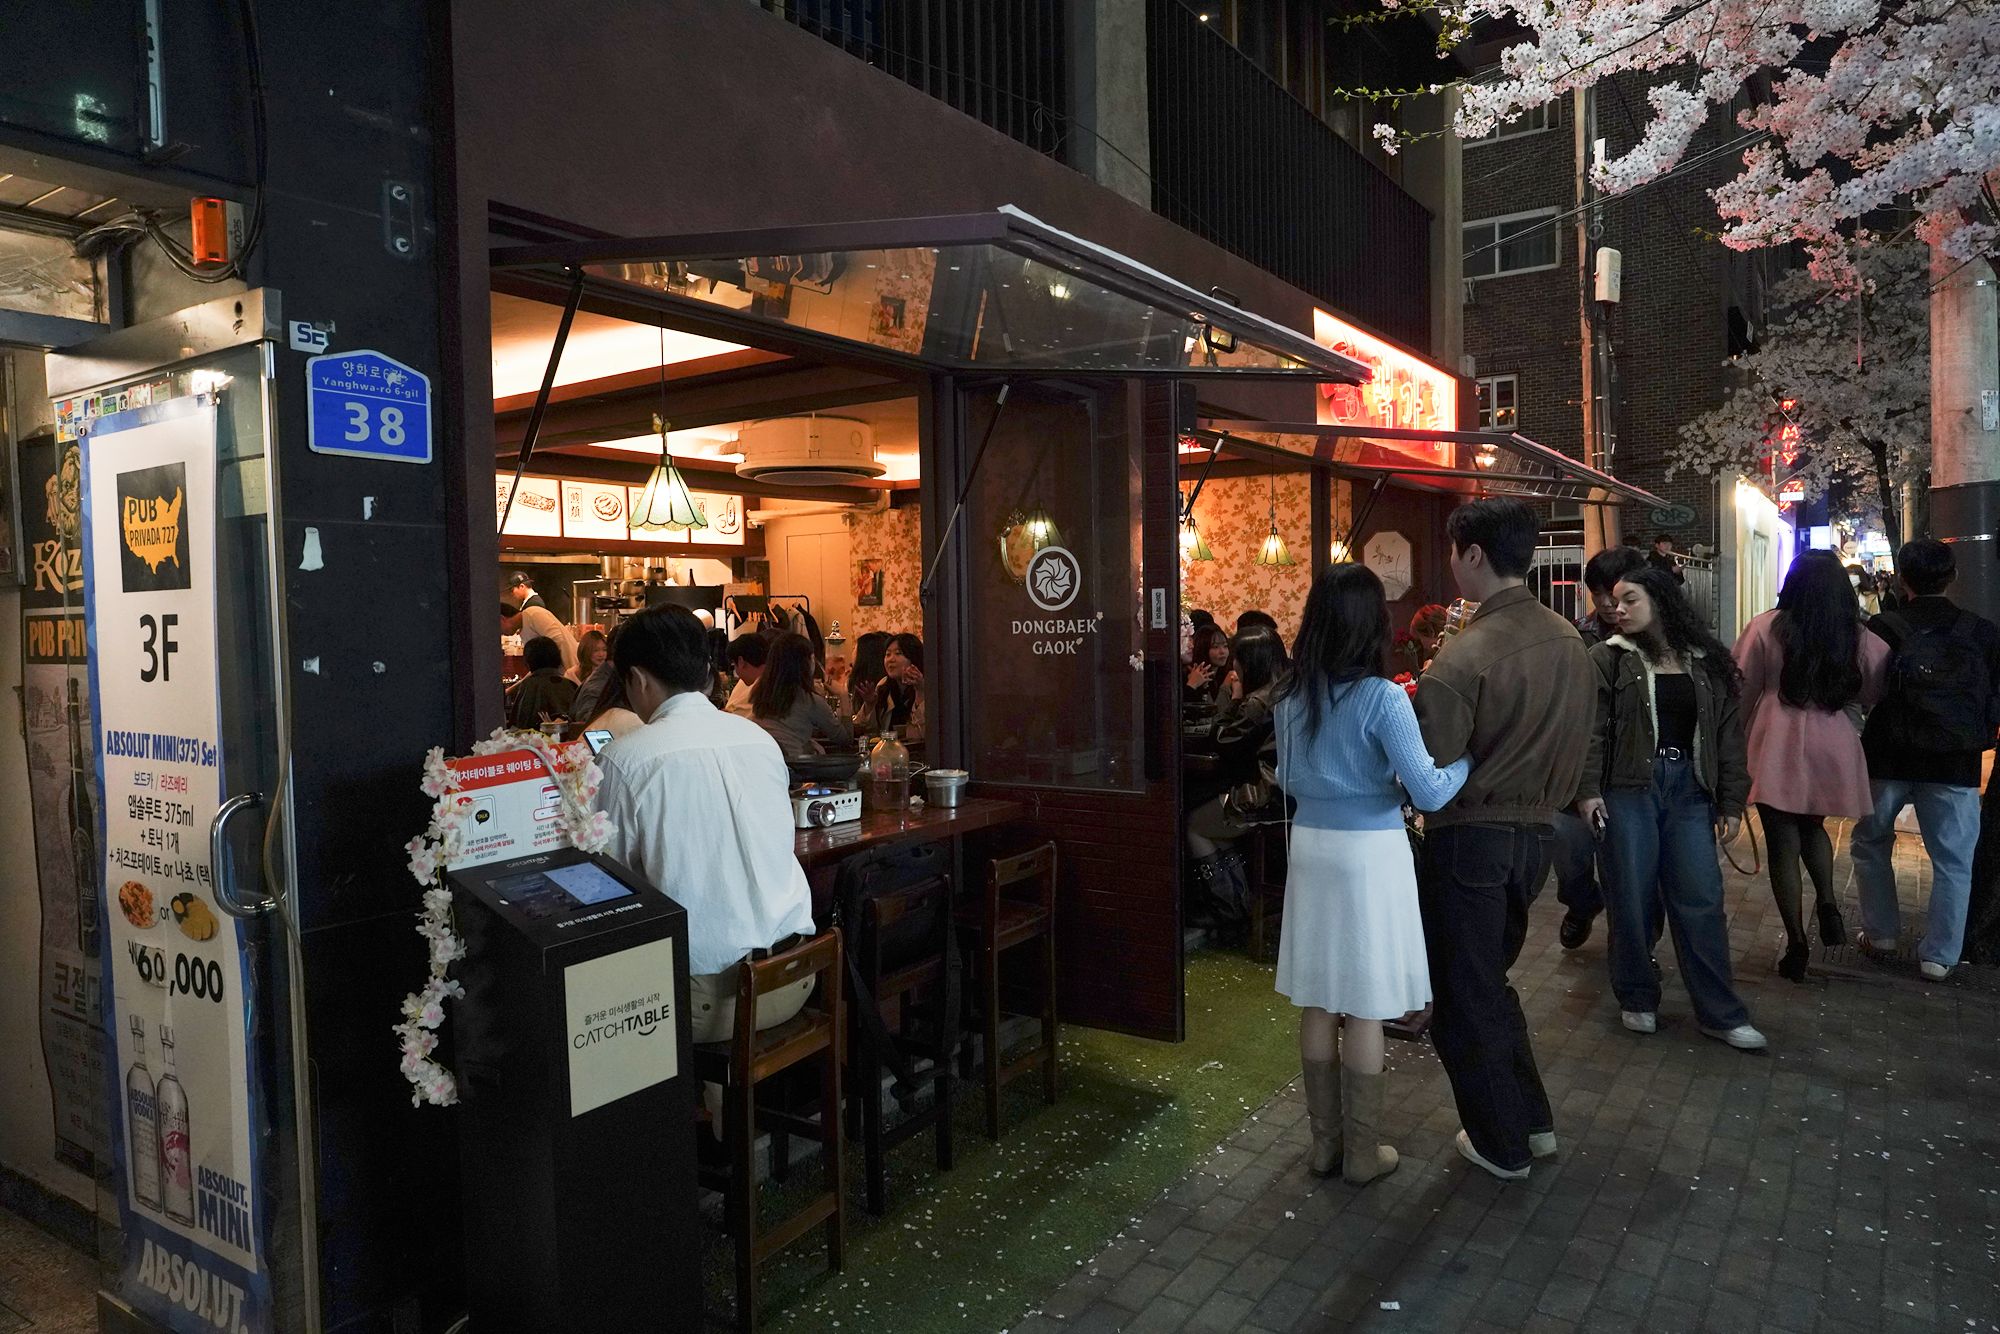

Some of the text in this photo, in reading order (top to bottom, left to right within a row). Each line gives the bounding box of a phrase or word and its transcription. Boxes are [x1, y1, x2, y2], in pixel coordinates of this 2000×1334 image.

[322, 376, 419, 399] Yanghwa-ro 6-gil
[345, 402, 406, 446] 38
[128, 499, 157, 524] PUB
[129, 525, 176, 547] PRIVADA 727
[29, 620, 55, 657] PUB
[1012, 618, 1098, 634] DONGBAEK
[139, 614, 178, 682] 3F
[1032, 640, 1077, 655] GAOK
[107, 730, 217, 767] ABSOLUT MINI(375) Set
[134, 771, 154, 789] 보드카
[160, 774, 188, 794] 라즈베리
[506, 759, 531, 774] 웨이팅
[128, 795, 194, 827] 앱솔루트 375ml
[147, 828, 163, 851] 토닉
[166, 832, 180, 855] 1개
[116, 847, 163, 875] 치즈포테이토
[164, 863, 173, 878] or
[174, 860, 195, 883] 나쵸
[160, 906, 170, 920] or
[584, 992, 660, 1026] 즐거운 미식생활의 시작
[573, 1004, 670, 1049] CATCHTABLE
[198, 1165, 248, 1208] ABSOLUT.
[198, 1188, 252, 1253] MINI
